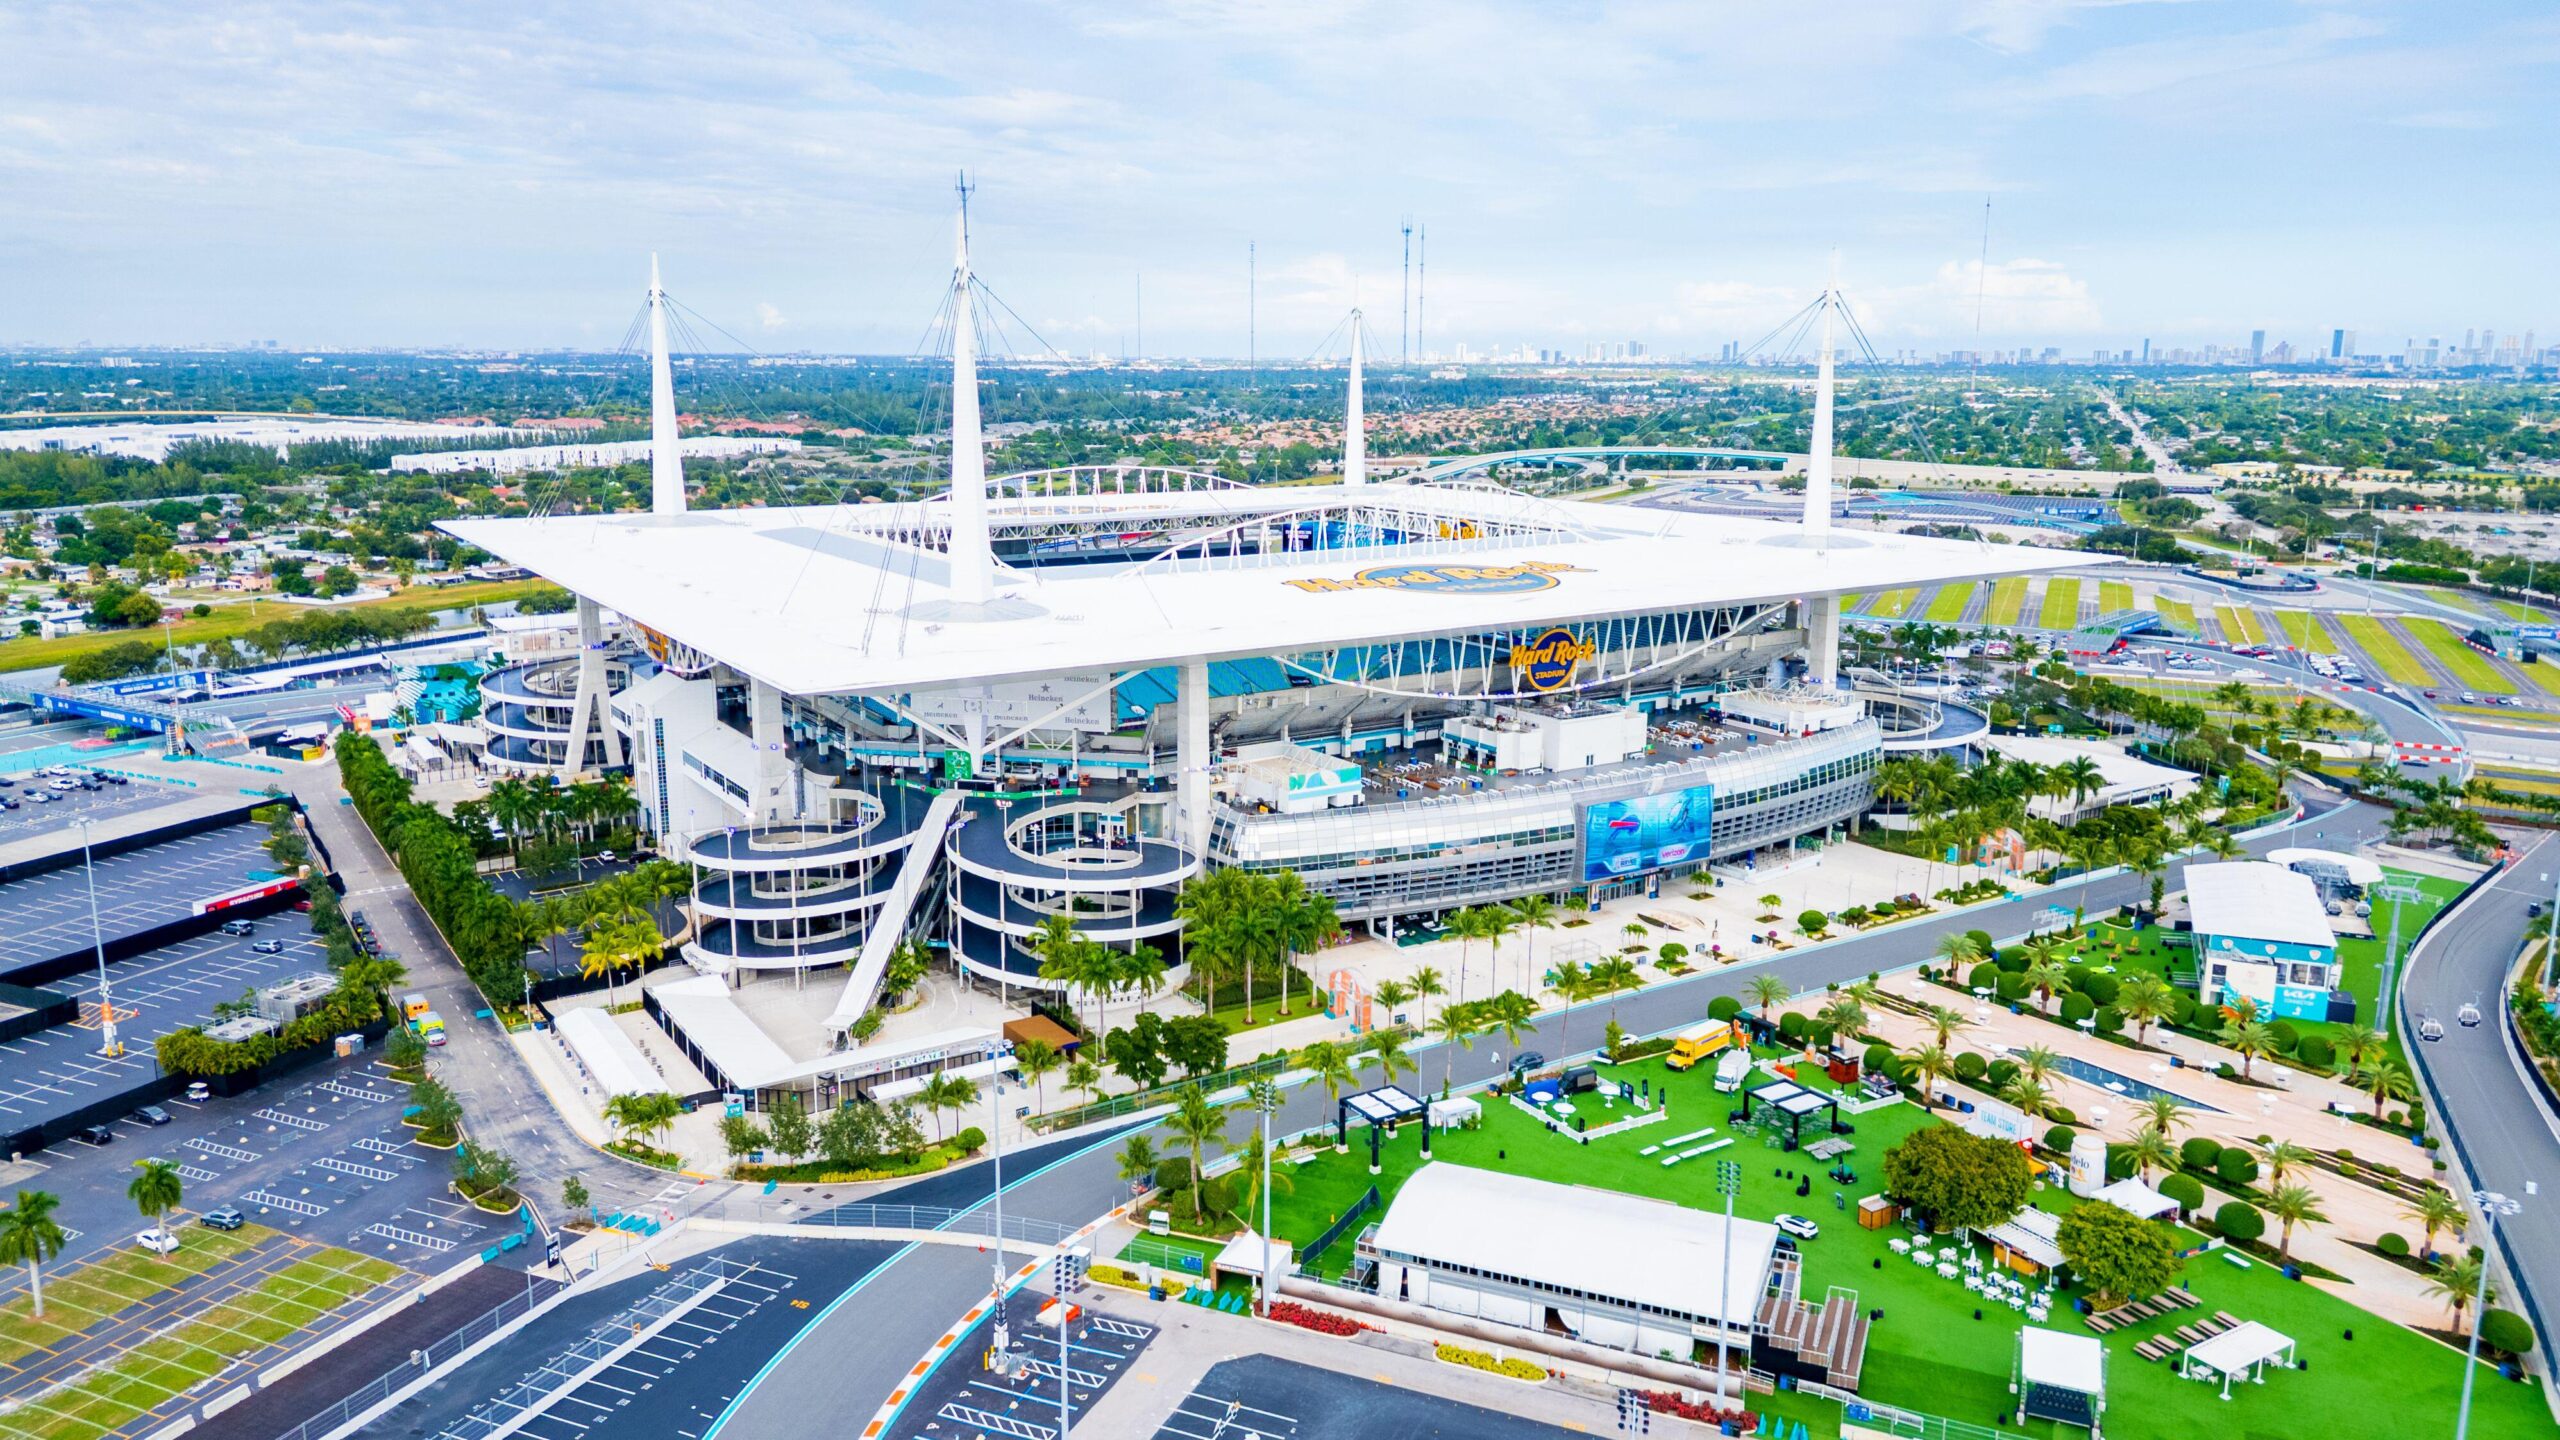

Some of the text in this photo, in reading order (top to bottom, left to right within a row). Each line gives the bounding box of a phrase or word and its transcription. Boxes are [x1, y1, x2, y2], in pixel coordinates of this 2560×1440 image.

[1281, 561, 1597, 593] Hard Rock
[1508, 636, 1595, 667] Hard Rock
[1535, 669, 1566, 680] STADIUM
[1028, 693, 1063, 702] Heineken
[1064, 716, 1100, 725] Heineken
[1661, 847, 1686, 859] verizon
[1980, 1110, 2017, 1135] TEAM STORE
